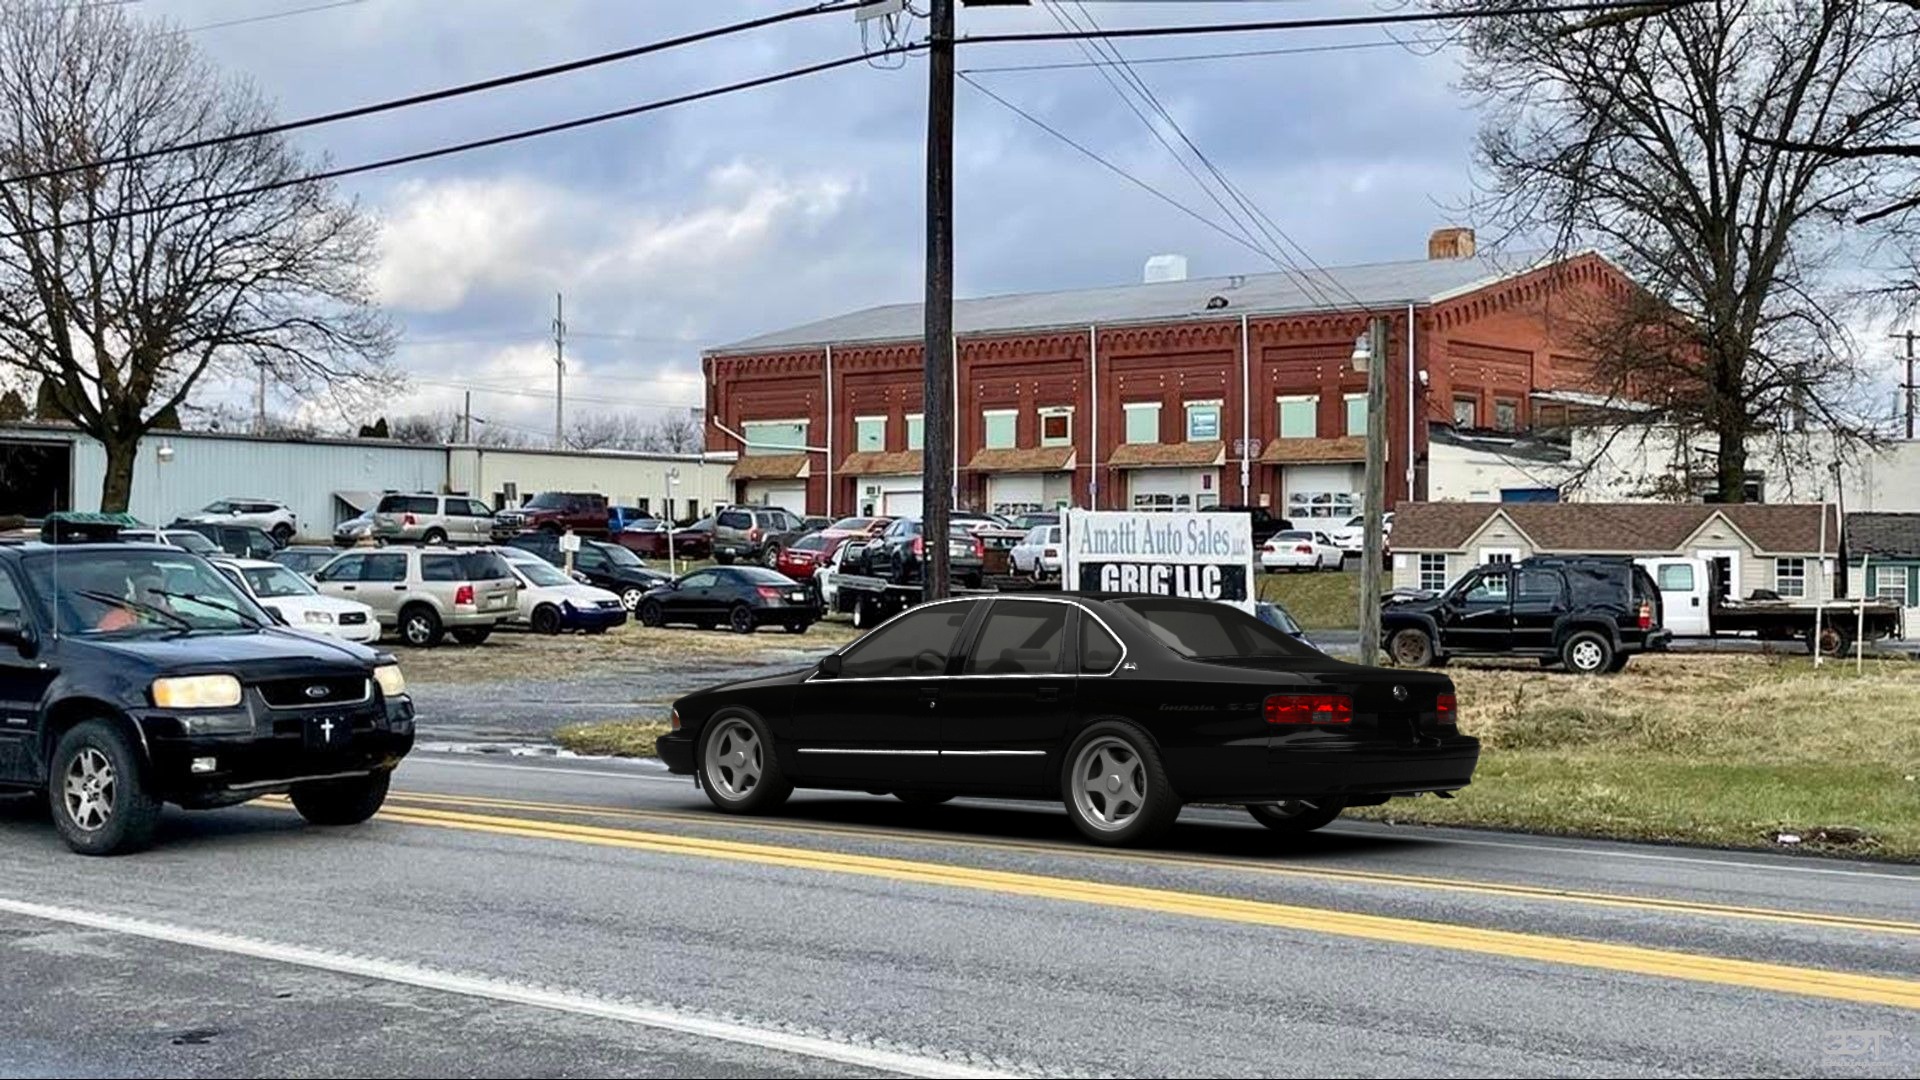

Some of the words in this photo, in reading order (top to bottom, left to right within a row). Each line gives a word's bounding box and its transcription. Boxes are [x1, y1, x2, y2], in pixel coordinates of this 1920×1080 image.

[1079, 518, 1136, 554] Amatti
[1142, 519, 1182, 555] Auto
[1187, 519, 1230, 555] Sales
[1175, 565, 1221, 599] LLC
